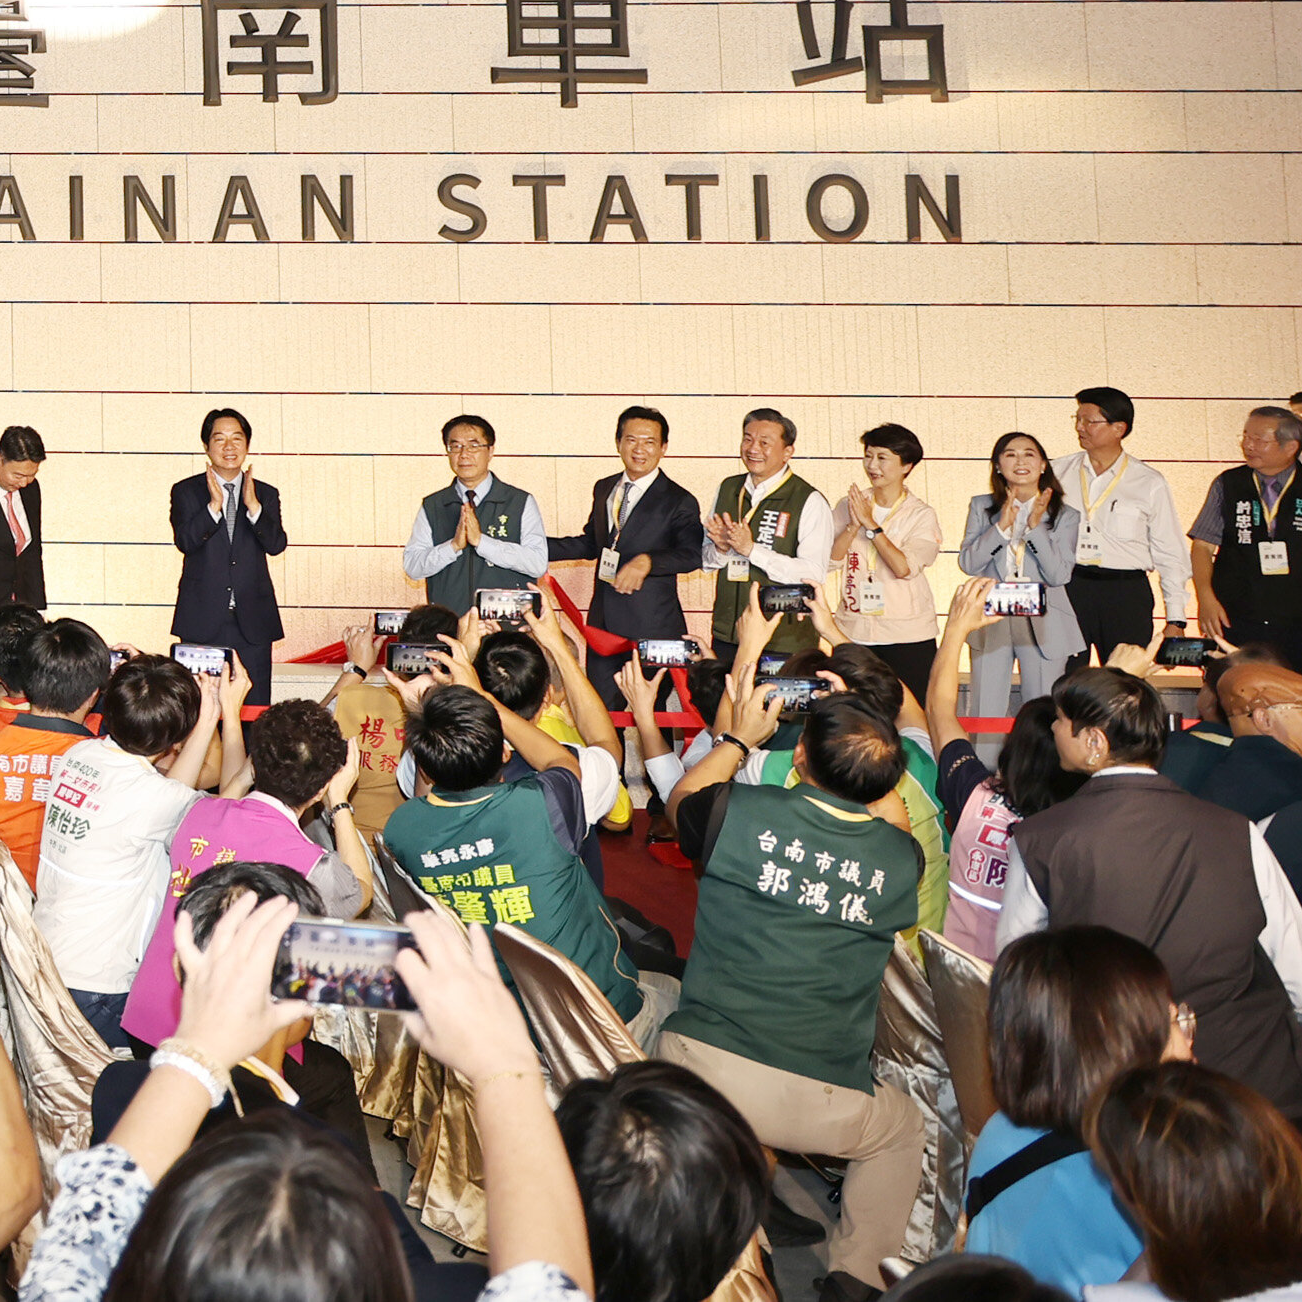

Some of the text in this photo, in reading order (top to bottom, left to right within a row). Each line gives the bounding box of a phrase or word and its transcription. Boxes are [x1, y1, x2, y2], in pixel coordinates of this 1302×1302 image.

[437, 172, 961, 243] STATION
[1235, 500, 1253, 545] 許忠信
[756, 860, 874, 926] 郭鴻儀
[757, 830, 886, 896] 台南市議員
[437, 885, 535, 924] 肇輝
